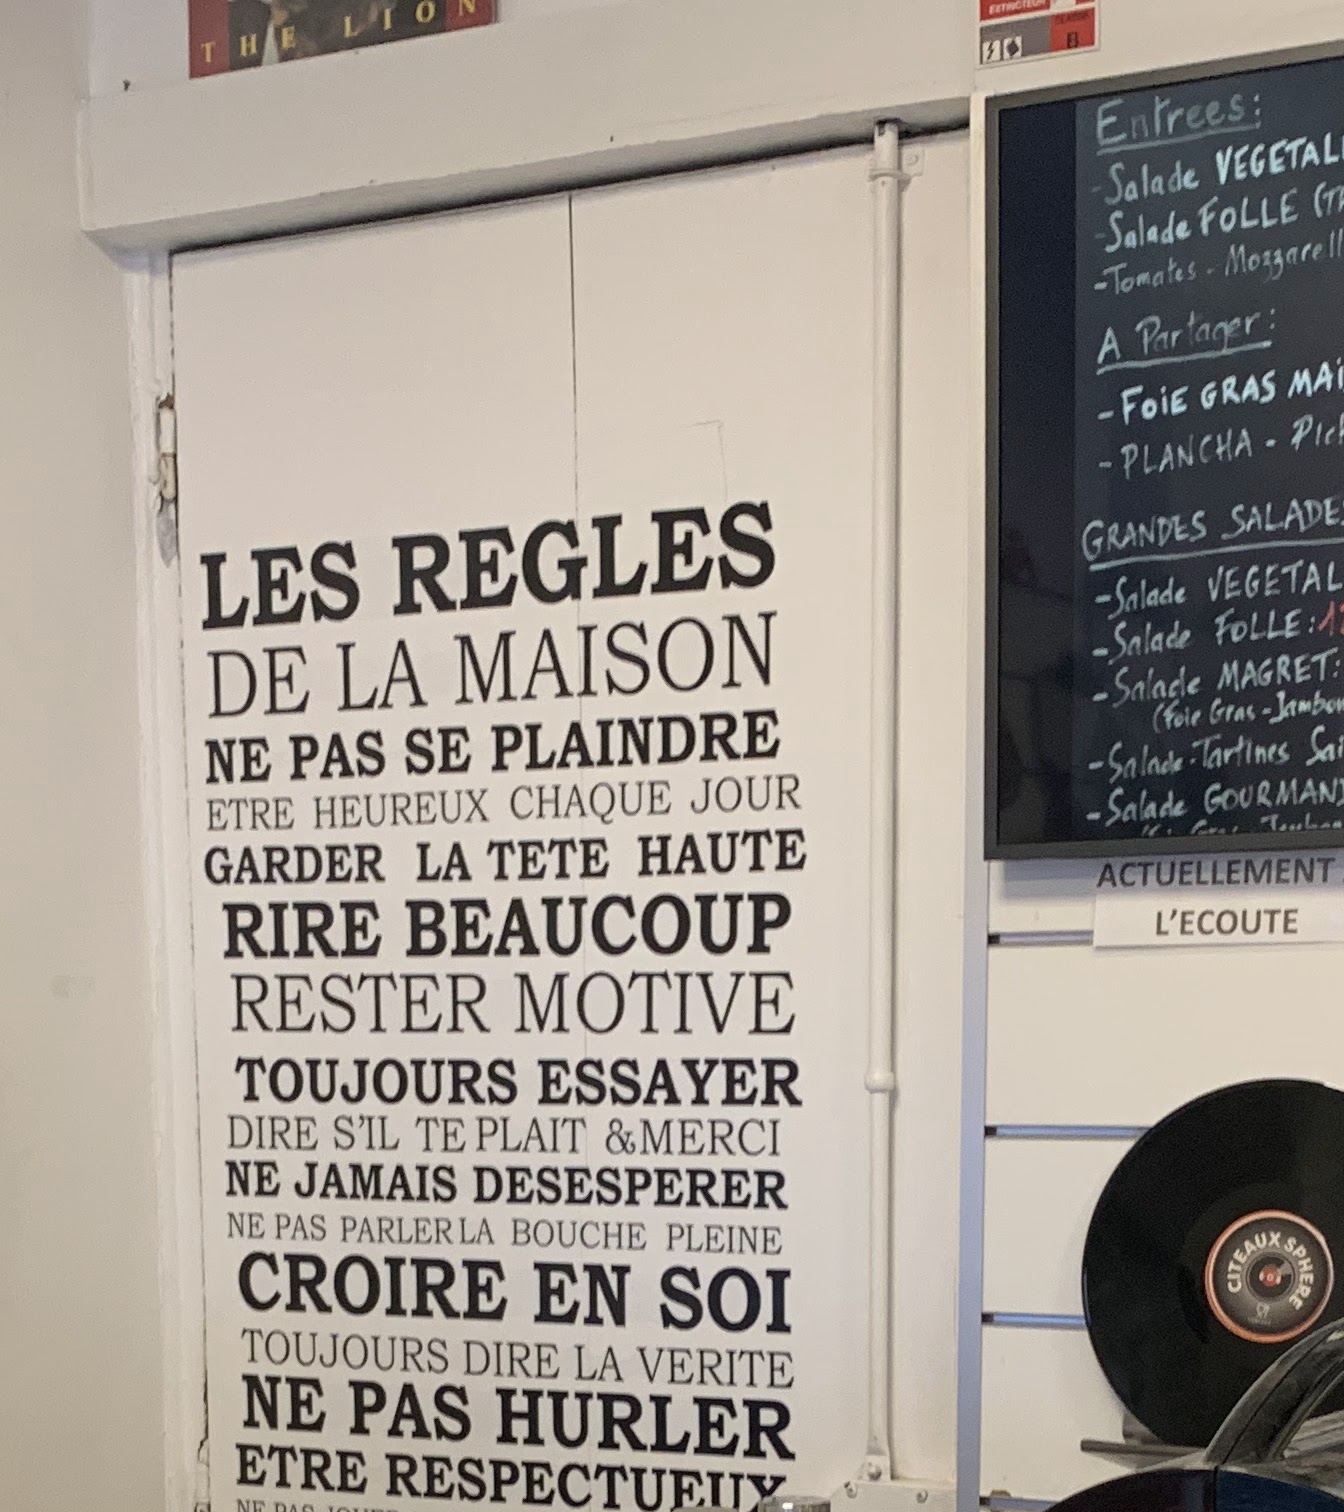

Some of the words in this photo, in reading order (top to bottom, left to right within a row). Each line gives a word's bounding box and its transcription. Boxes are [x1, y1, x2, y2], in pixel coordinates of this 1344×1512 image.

[201, 25, 295, 63] THE
[344, 0, 477, 39] LION
[1199, 189, 1299, 235] FOLLE
[1099, 325, 1119, 363] A
[1201, 373, 1277, 411] GRAS
[1122, 437, 1253, 480] PLANCHA
[1082, 510, 1207, 560] GRANDES
[201, 541, 361, 629] LES
[392, 501, 776, 615] REGLES
[208, 646, 310, 717] DE
[338, 639, 427, 712] LA
[455, 611, 778, 704] MAISON
[205, 738, 272, 784] NE
[290, 729, 386, 780] PAS
[405, 728, 472, 774] SE
[491, 709, 781, 771] PLAINDRE
[206, 796, 294, 831] ETRE
[313, 788, 489, 829] HEUREUX
[510, 781, 672, 823] CHAQUE
[690, 774, 802, 814] JOUR
[205, 843, 385, 885] GARDER
[417, 842, 472, 881] LA
[487, 838, 609, 879] TETE
[637, 829, 807, 876] HAUTE
[1097, 856, 1334, 890] ACTUELLEMENT
[223, 900, 382, 957] RIRE
[406, 892, 792, 956] BEAUCOUP
[1155, 908, 1299, 938] L'ECOUTE
[294, 1163, 457, 1201] JAMAIS
[473, 1167, 789, 1209] DESESPERER
[340, 1215, 451, 1245] PARLER
[512, 1222, 646, 1250] BOUCHE
[666, 1224, 782, 1255] PLEINE
[238, 1252, 507, 1320] CROIRE
[533, 1262, 631, 1326] EN
[659, 1267, 793, 1333] SOI
[1227, 1231, 1281, 1293] CITEAUX
[1284, 1237, 1314, 1311] SPHERE
